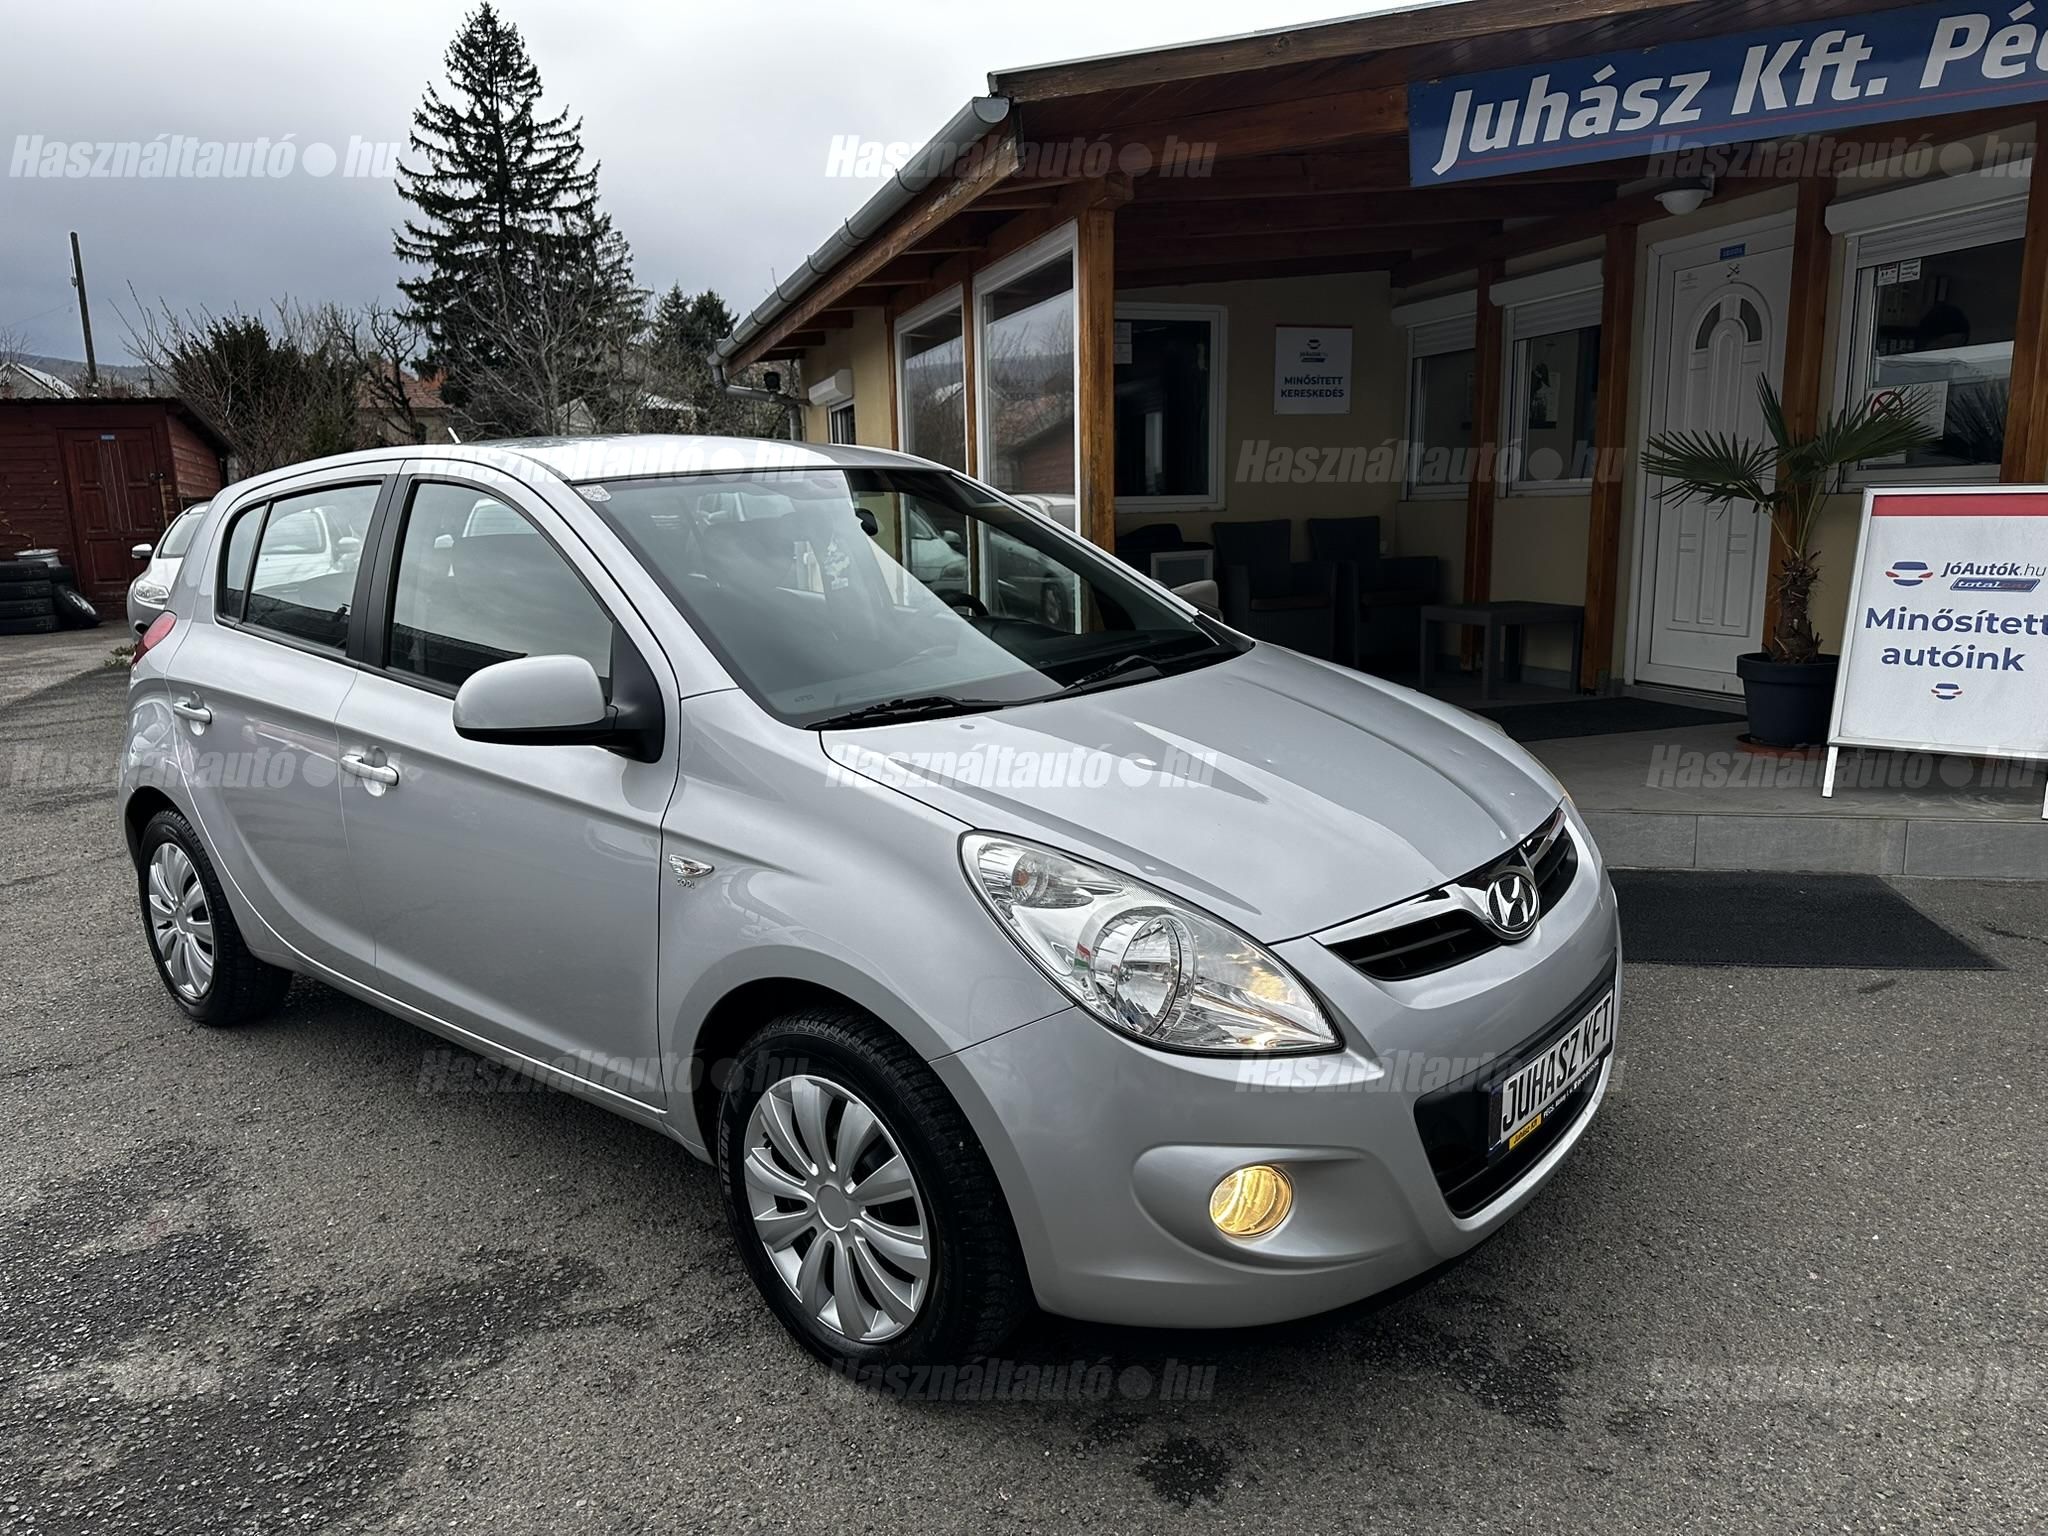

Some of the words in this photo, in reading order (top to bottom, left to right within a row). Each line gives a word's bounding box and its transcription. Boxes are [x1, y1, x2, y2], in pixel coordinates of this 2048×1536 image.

[1432, 64, 1710, 176] Juhász
[1730, 30, 1888, 116] Kft.
[1280, 387, 1345, 398] KERESKEDÉS
[1284, 374, 1344, 385] MINŐSÍTETT
[1940, 561, 2047, 578] JóAutók.hu
[1865, 606, 2048, 636] Minősített
[1881, 644, 2026, 672] autóink
[1502, 1027, 1580, 1132] JUHASZ
[1582, 996, 1611, 1065] KFT
